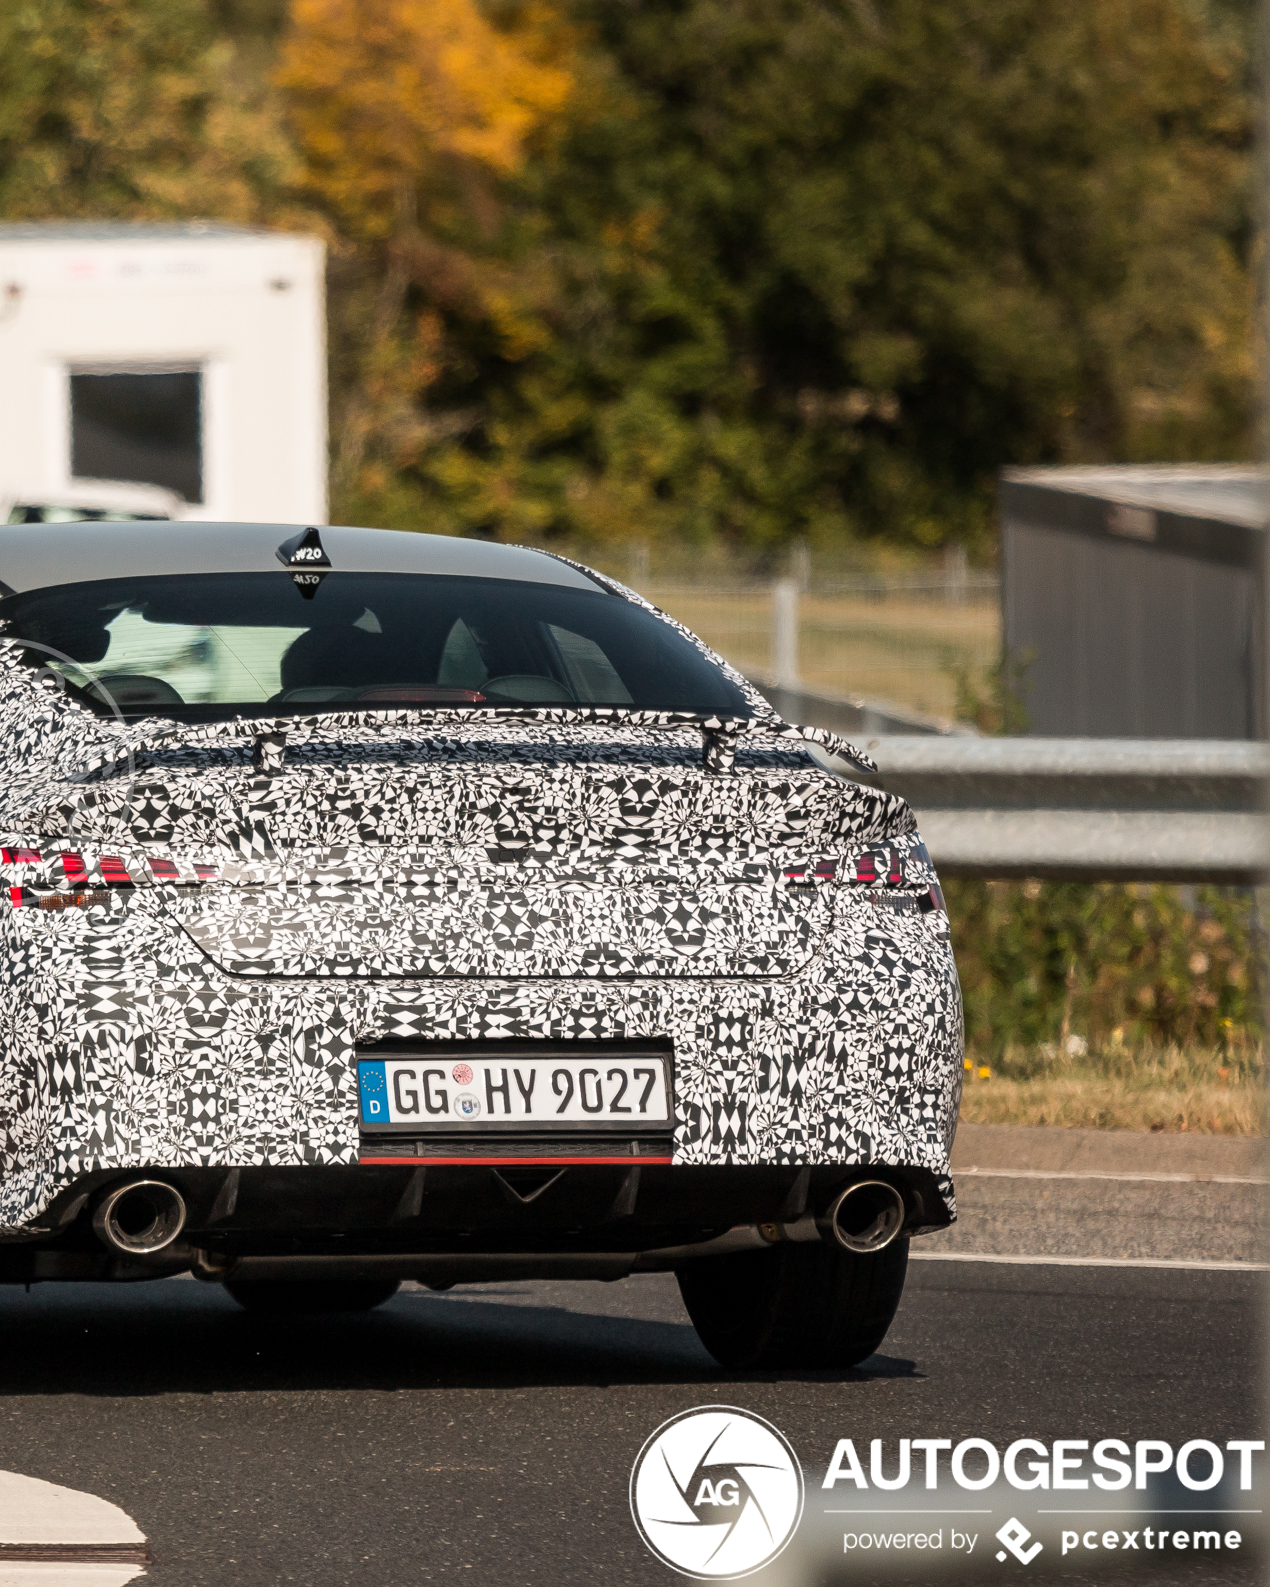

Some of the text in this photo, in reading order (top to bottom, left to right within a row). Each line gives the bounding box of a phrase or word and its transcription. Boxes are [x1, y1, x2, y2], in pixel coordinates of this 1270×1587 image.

[393, 1069, 450, 1115] GG
[483, 1068, 536, 1114] HY
[551, 1068, 657, 1114] 9027
[369, 1100, 381, 1115] D
